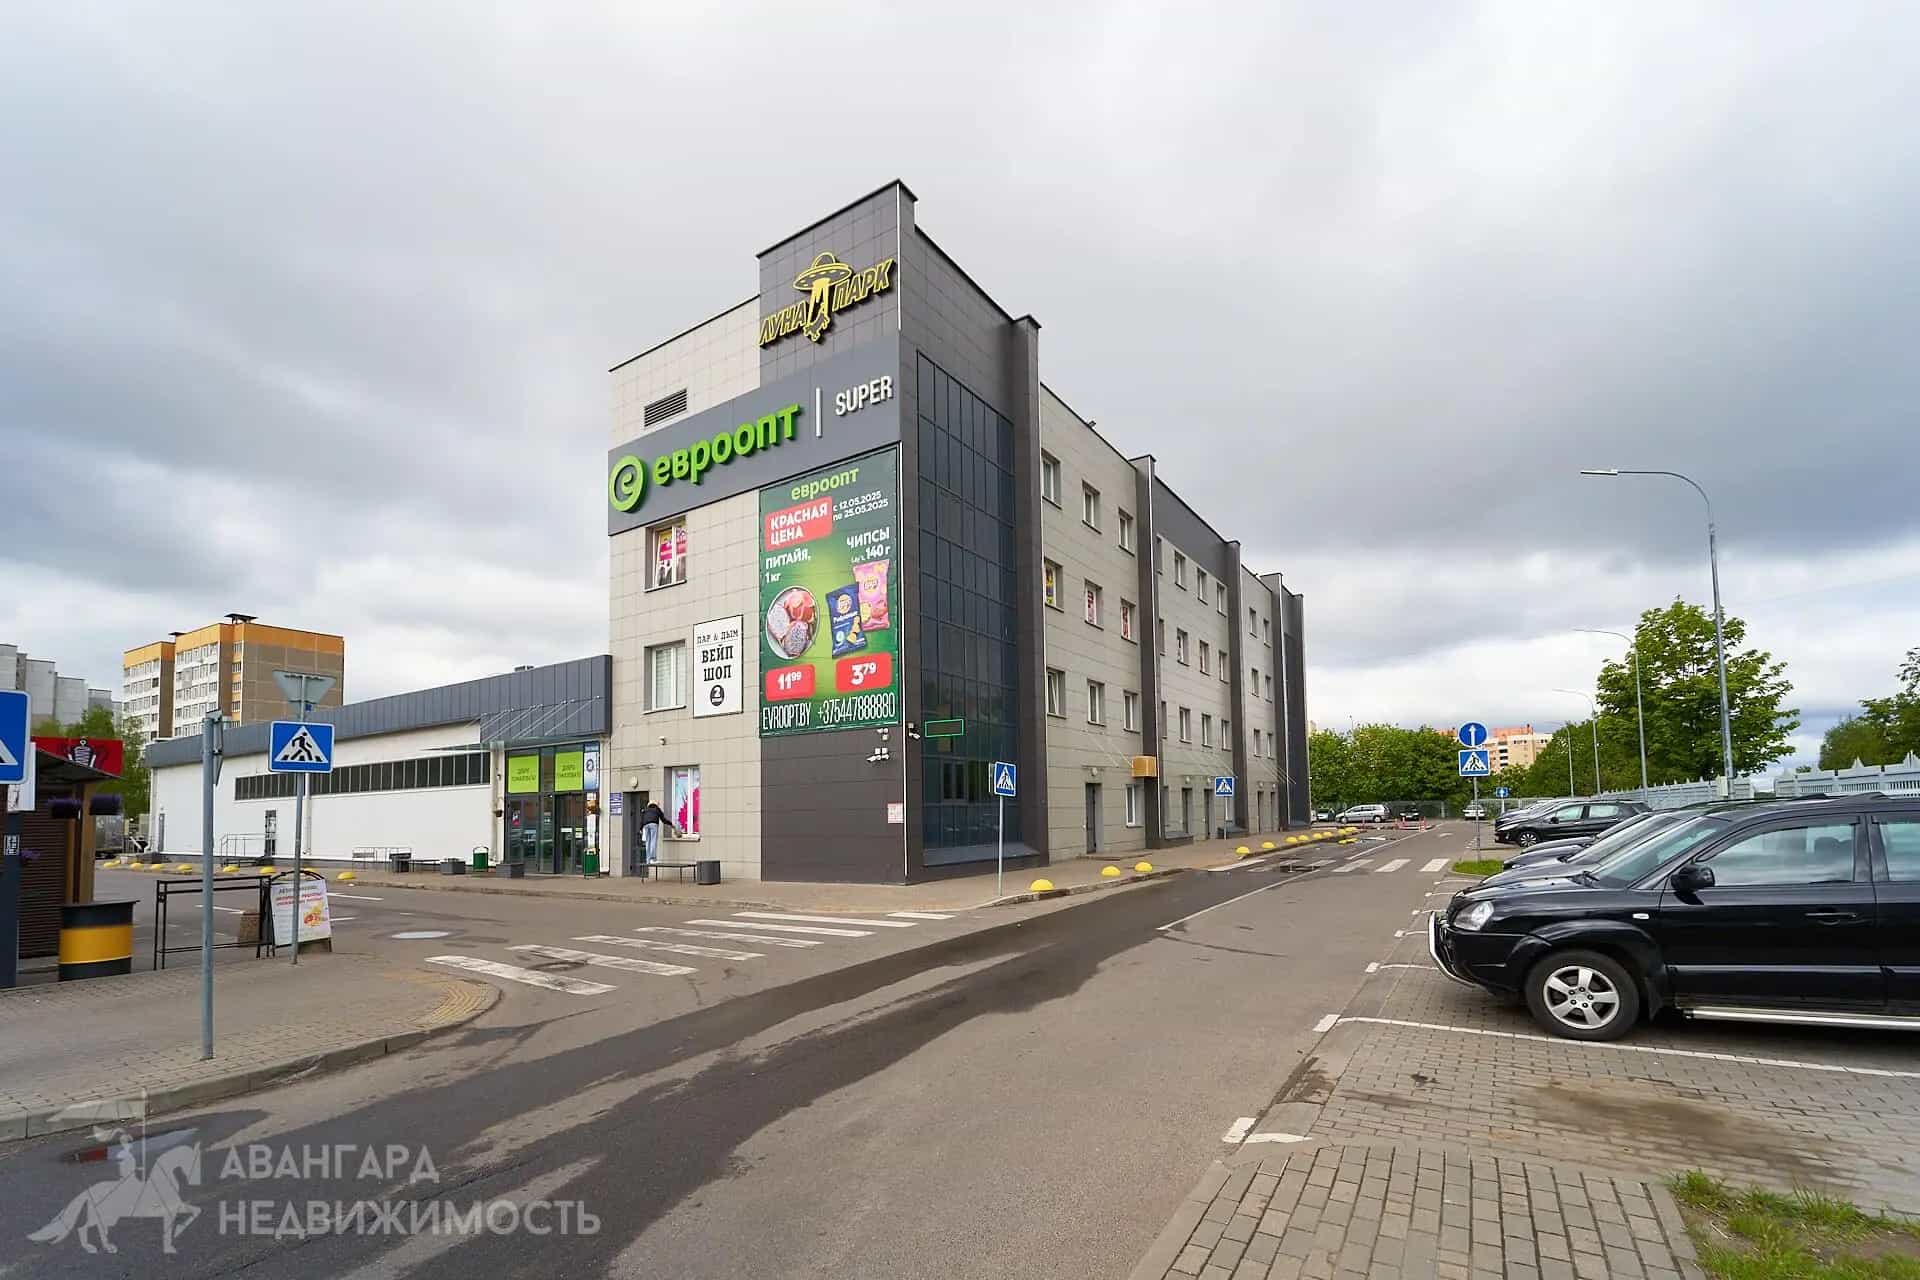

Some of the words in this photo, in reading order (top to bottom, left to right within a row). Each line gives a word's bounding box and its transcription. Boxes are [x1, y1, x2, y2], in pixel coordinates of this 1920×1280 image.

[759, 300, 808, 346] ЛУНА
[832, 258, 895, 313] ПАРК
[835, 374, 893, 417] SUPER
[652, 403, 801, 485] евроопт
[791, 468, 859, 500] евроопт
[770, 502, 829, 530] КРАСНАЯ
[844, 498, 889, 518] 25.05.2025
[770, 524, 804, 546] ЦЕНА
[846, 526, 890, 549] ЧИПСЫ
[702, 644, 734, 664] ВЕЙП
[703, 664, 732, 682] ШОП
[762, 702, 812, 730] EVROOPT.BY
[817, 692, 896, 725] +375447888880
